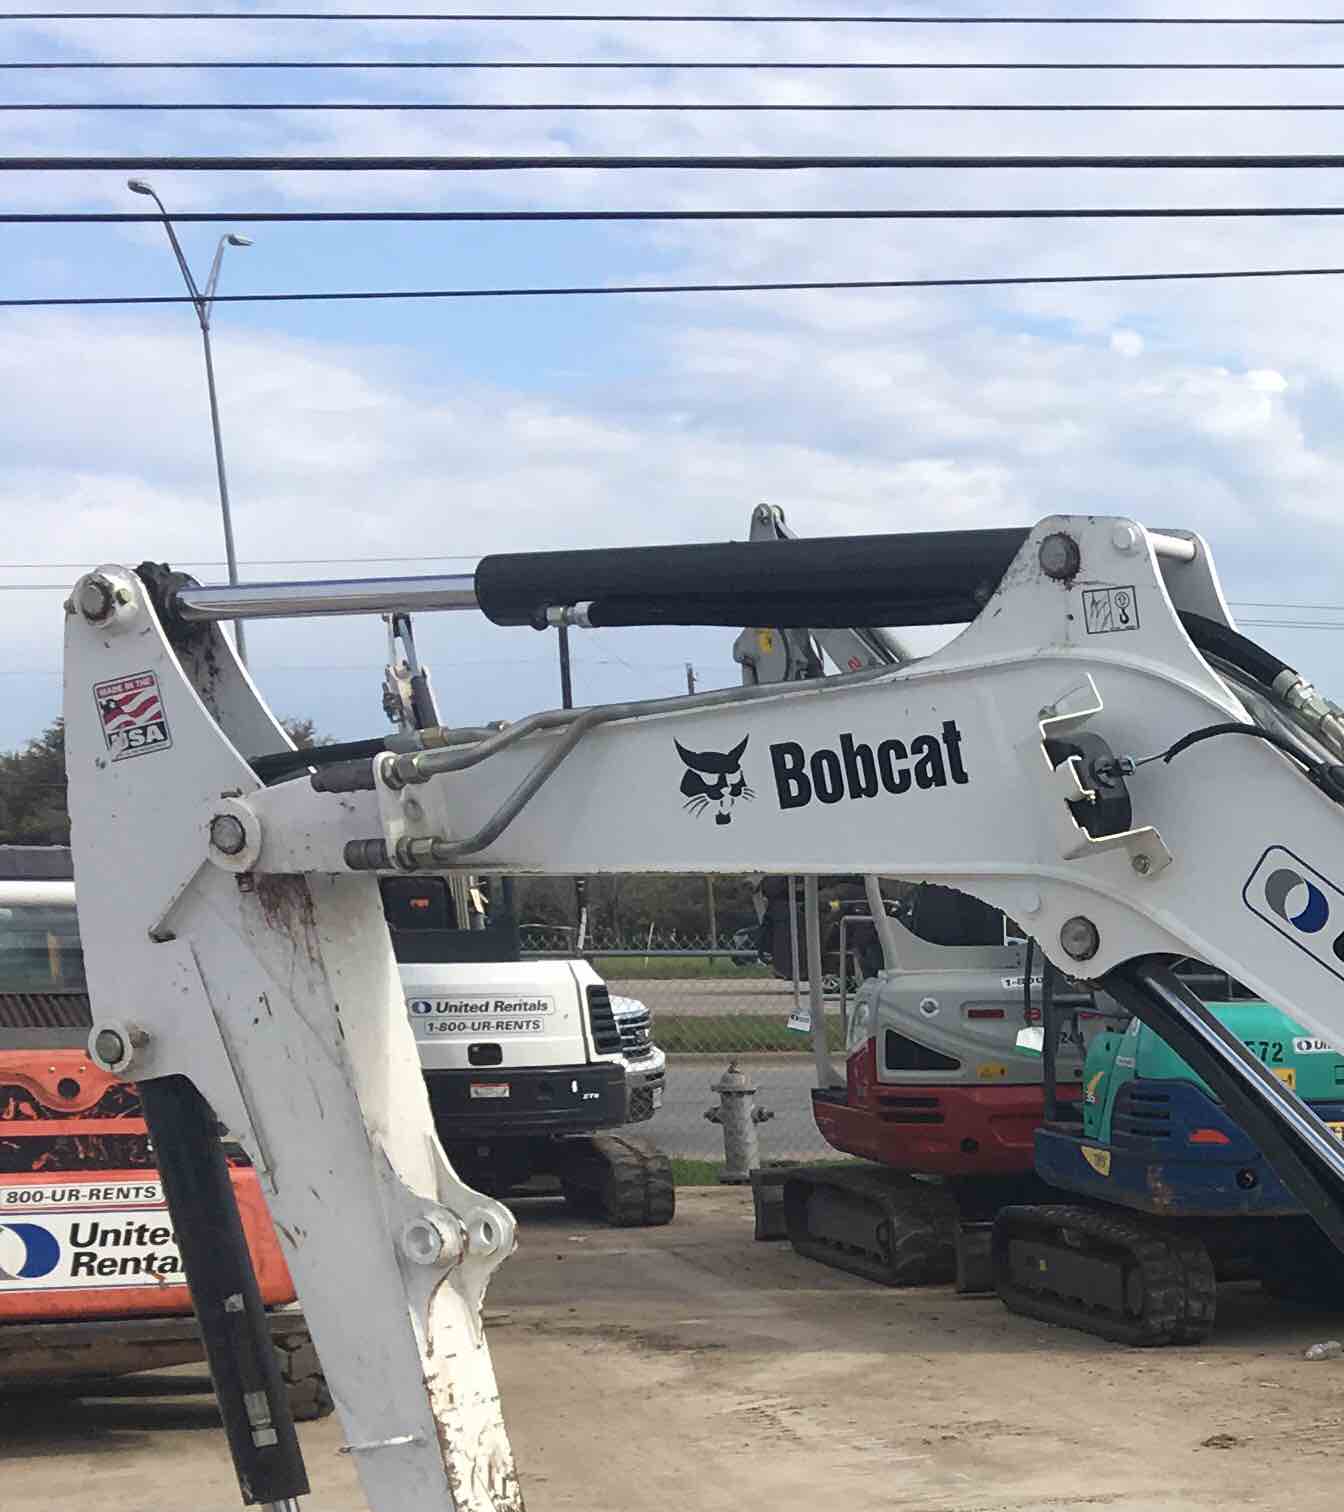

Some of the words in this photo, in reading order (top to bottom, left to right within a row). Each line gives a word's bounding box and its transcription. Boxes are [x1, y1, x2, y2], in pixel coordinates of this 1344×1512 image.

[111, 724, 164, 752] USA
[769, 719, 970, 810] Bobcat
[436, 1000, 488, 1014] United
[493, 999, 548, 1013] Rentals
[427, 1019, 541, 1033] 1-800-UR-RENTS
